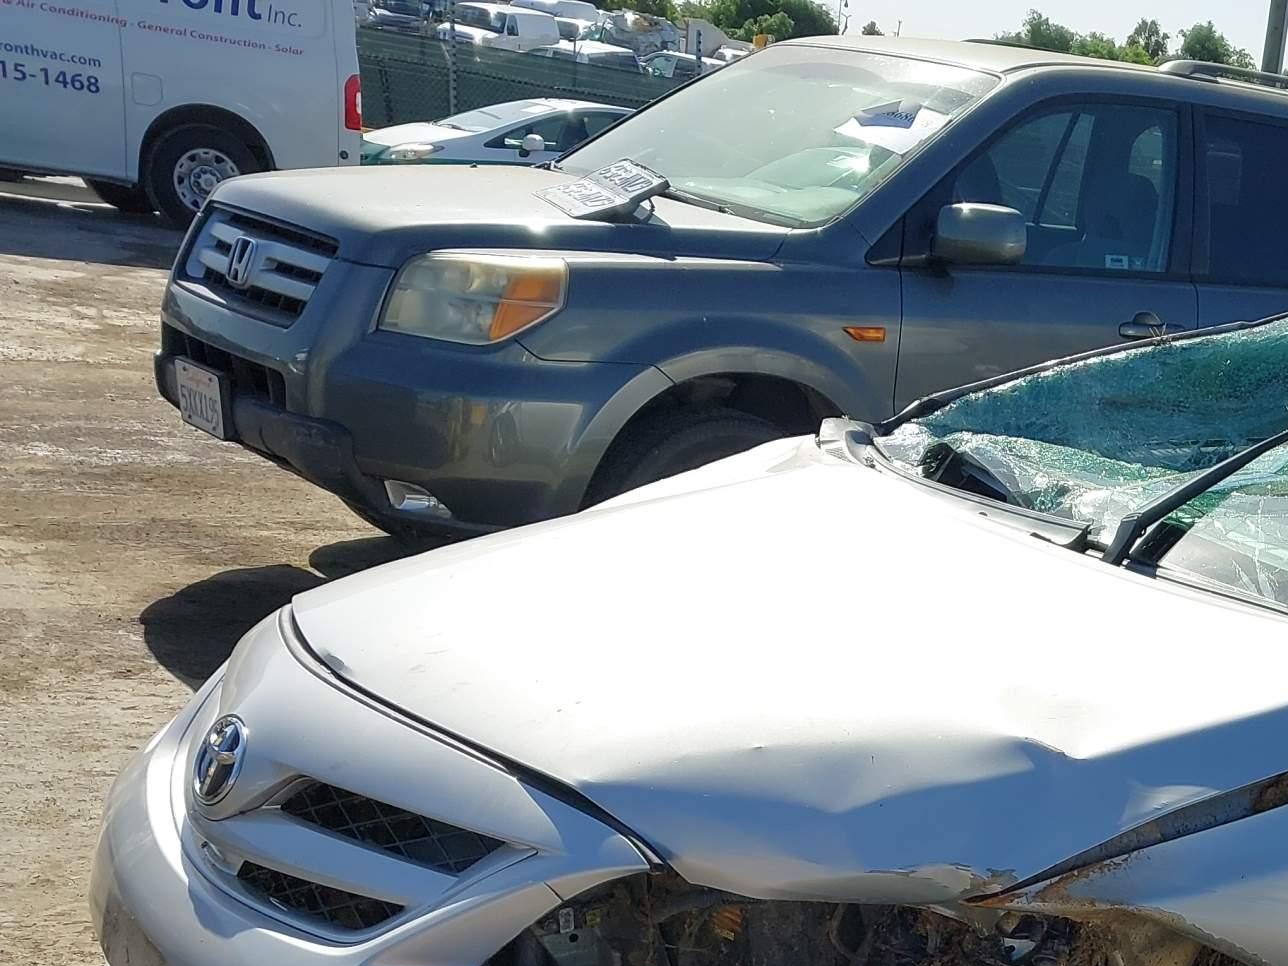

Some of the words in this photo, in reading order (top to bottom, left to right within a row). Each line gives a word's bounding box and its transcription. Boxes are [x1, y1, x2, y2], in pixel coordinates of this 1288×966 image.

[40, 2, 128, 28] Conditioning
[137, 20, 187, 37] General
[189, 30, 266, 51] Construction
[274, 43, 305, 56] Solar
[267, 4, 302, 28] Inc.
[0, 60, 100, 94] 15-1468
